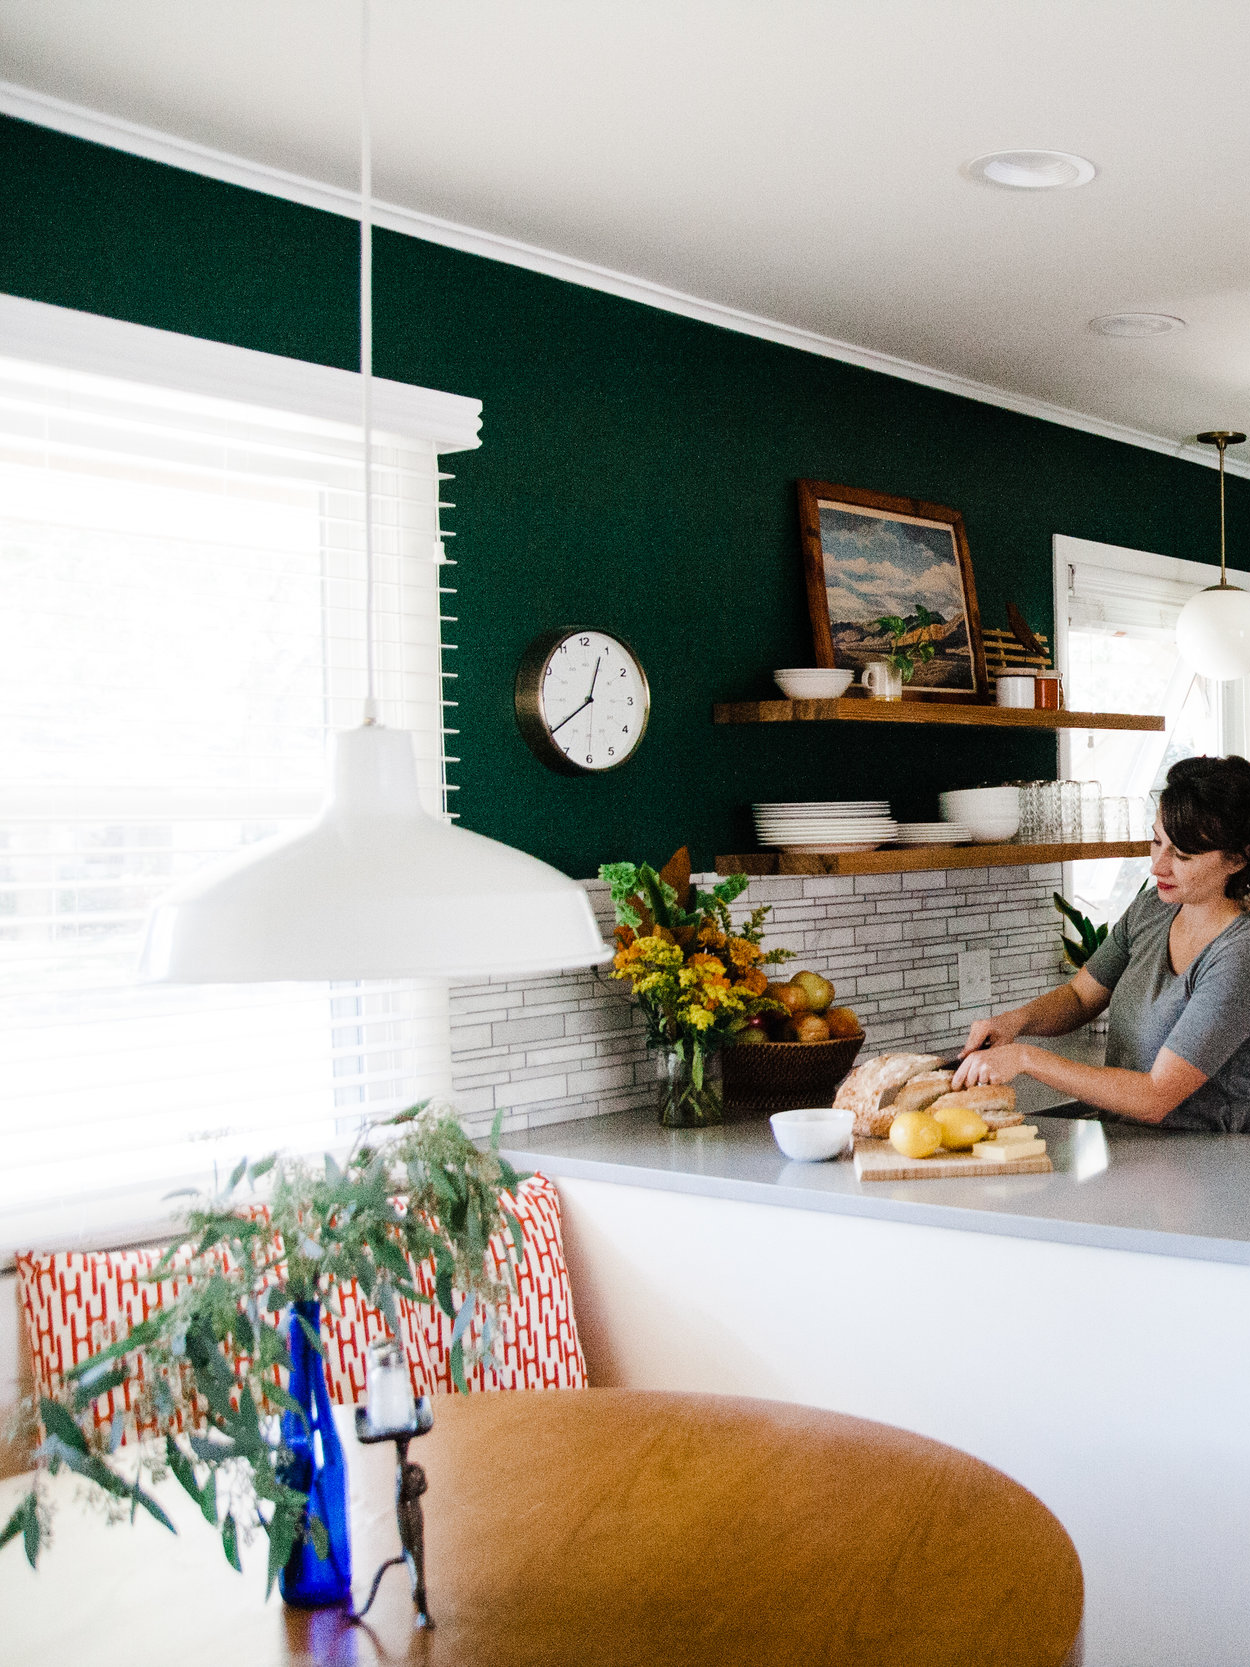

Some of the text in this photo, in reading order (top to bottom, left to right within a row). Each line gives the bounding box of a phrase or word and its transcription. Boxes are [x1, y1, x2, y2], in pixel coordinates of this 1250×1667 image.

[579, 637, 590, 646] 12
[560, 645, 567, 654] 11
[605, 646, 609, 655] 1
[620, 668, 627, 677] 2
[627, 696, 633, 706] 3
[622, 725, 628, 733] 4
[563, 747, 570, 755] 7
[608, 746, 614, 756] 5
[586, 754, 593, 764] 6
